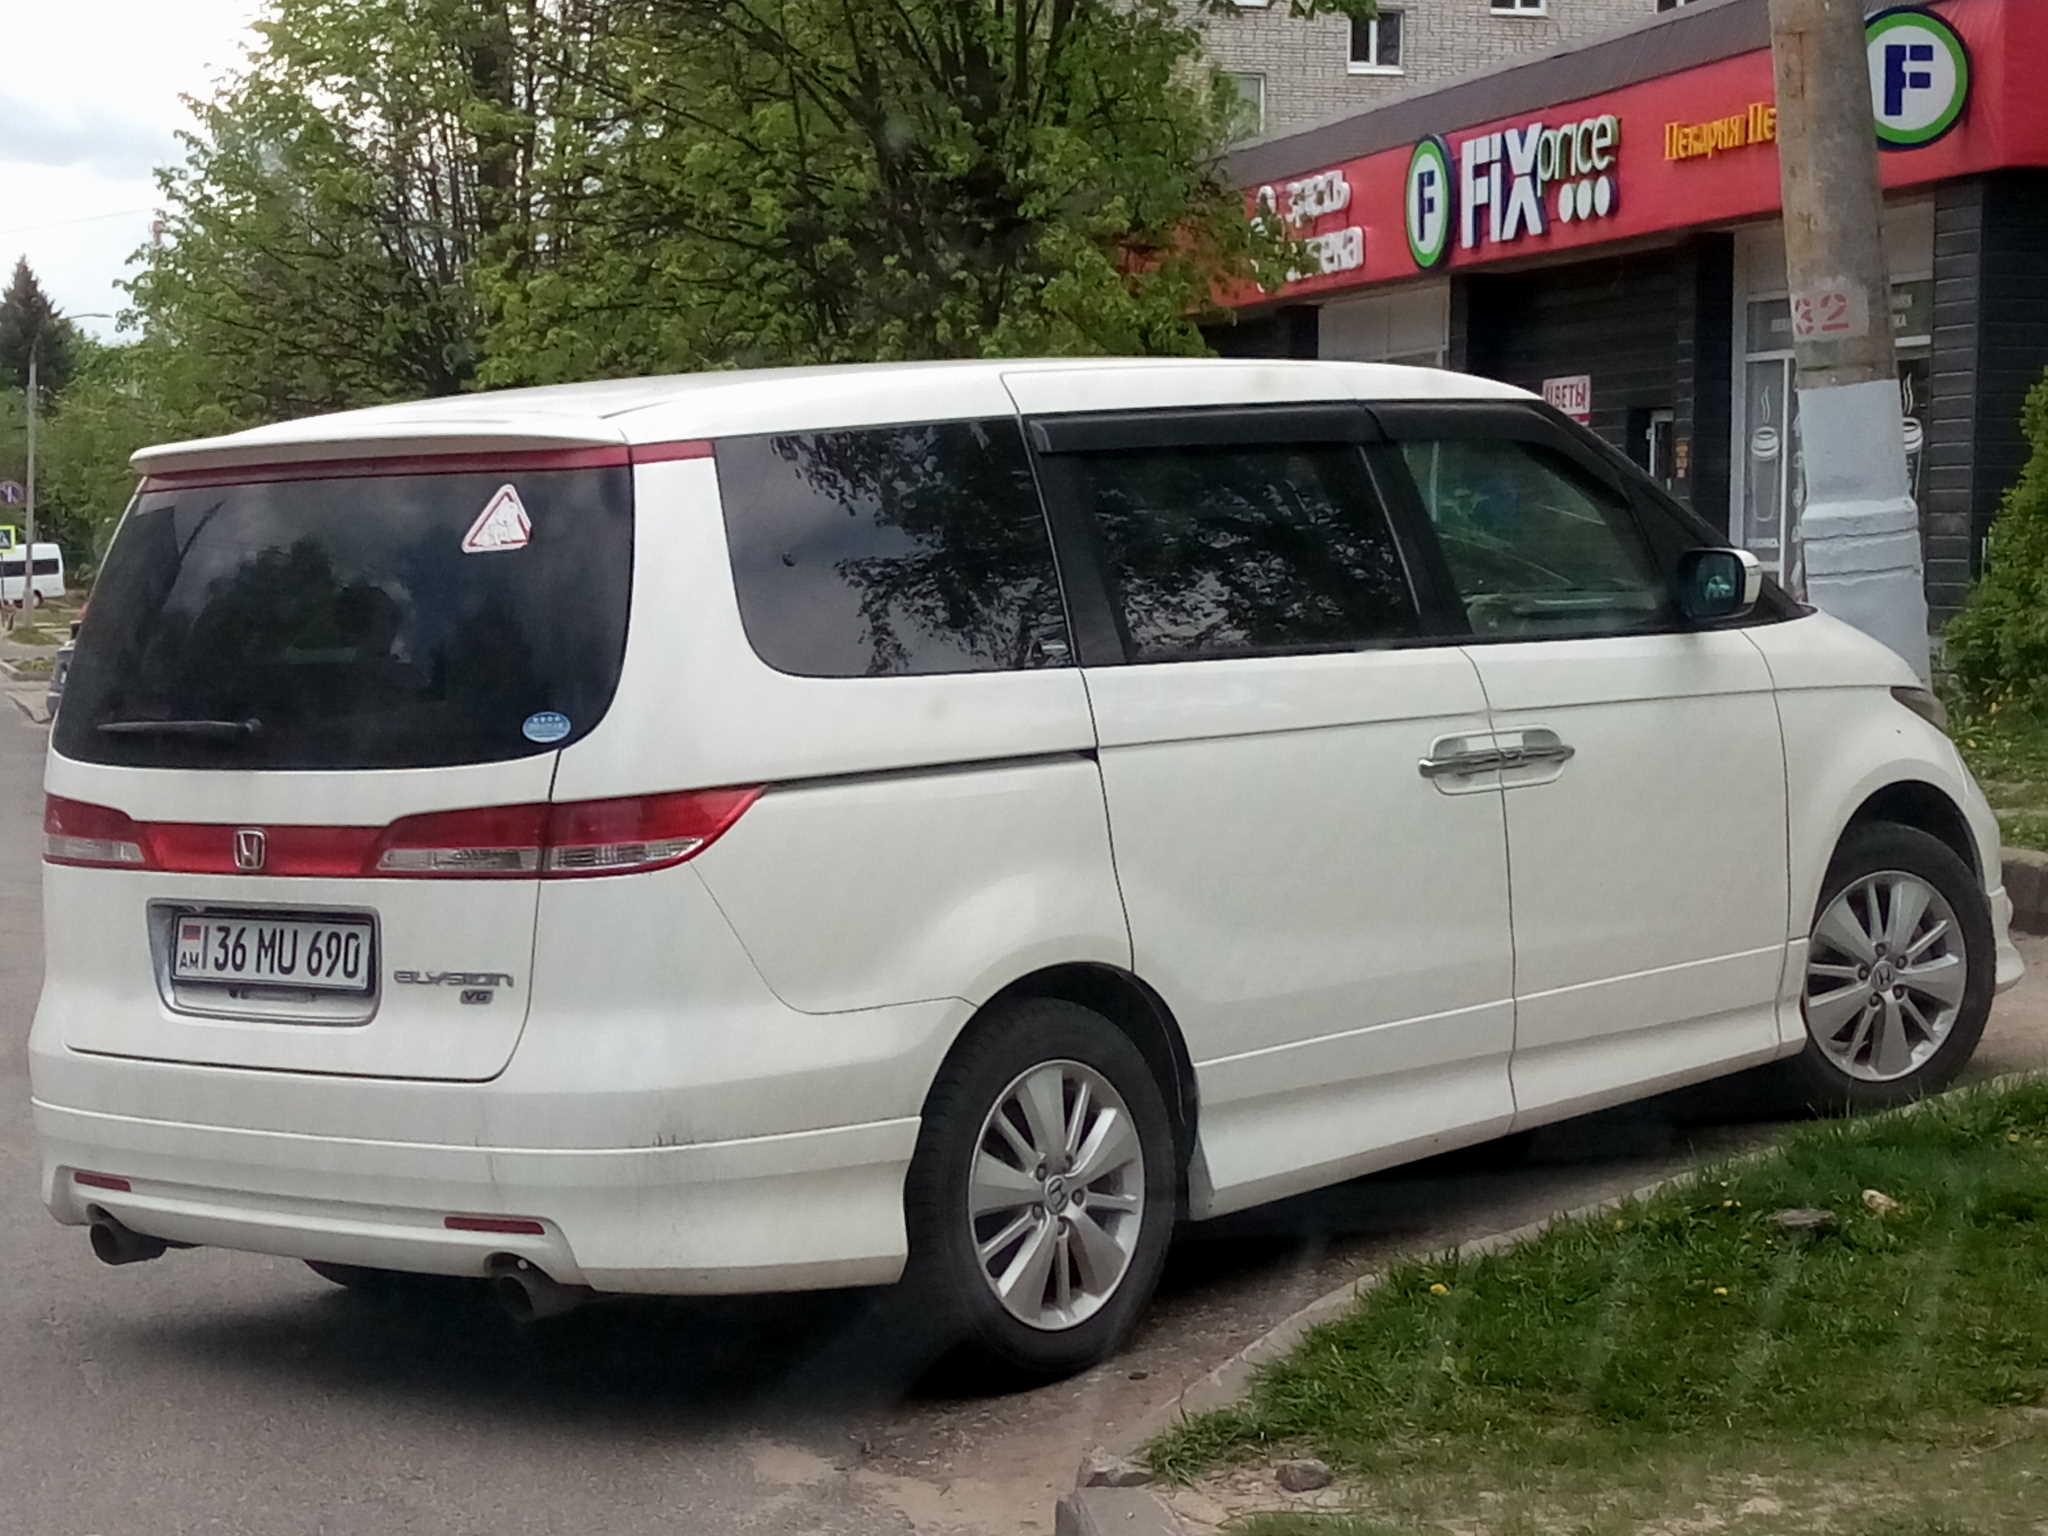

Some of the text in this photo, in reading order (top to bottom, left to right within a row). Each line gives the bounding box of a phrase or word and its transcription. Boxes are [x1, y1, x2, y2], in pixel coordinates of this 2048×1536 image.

[1538, 114, 1616, 198] price
[1663, 102, 1777, 160] Пекарня Пе
[1794, 293, 1850, 335] 32
[179, 950, 199, 969] AM
[213, 925, 360, 979] 36 MU 690
